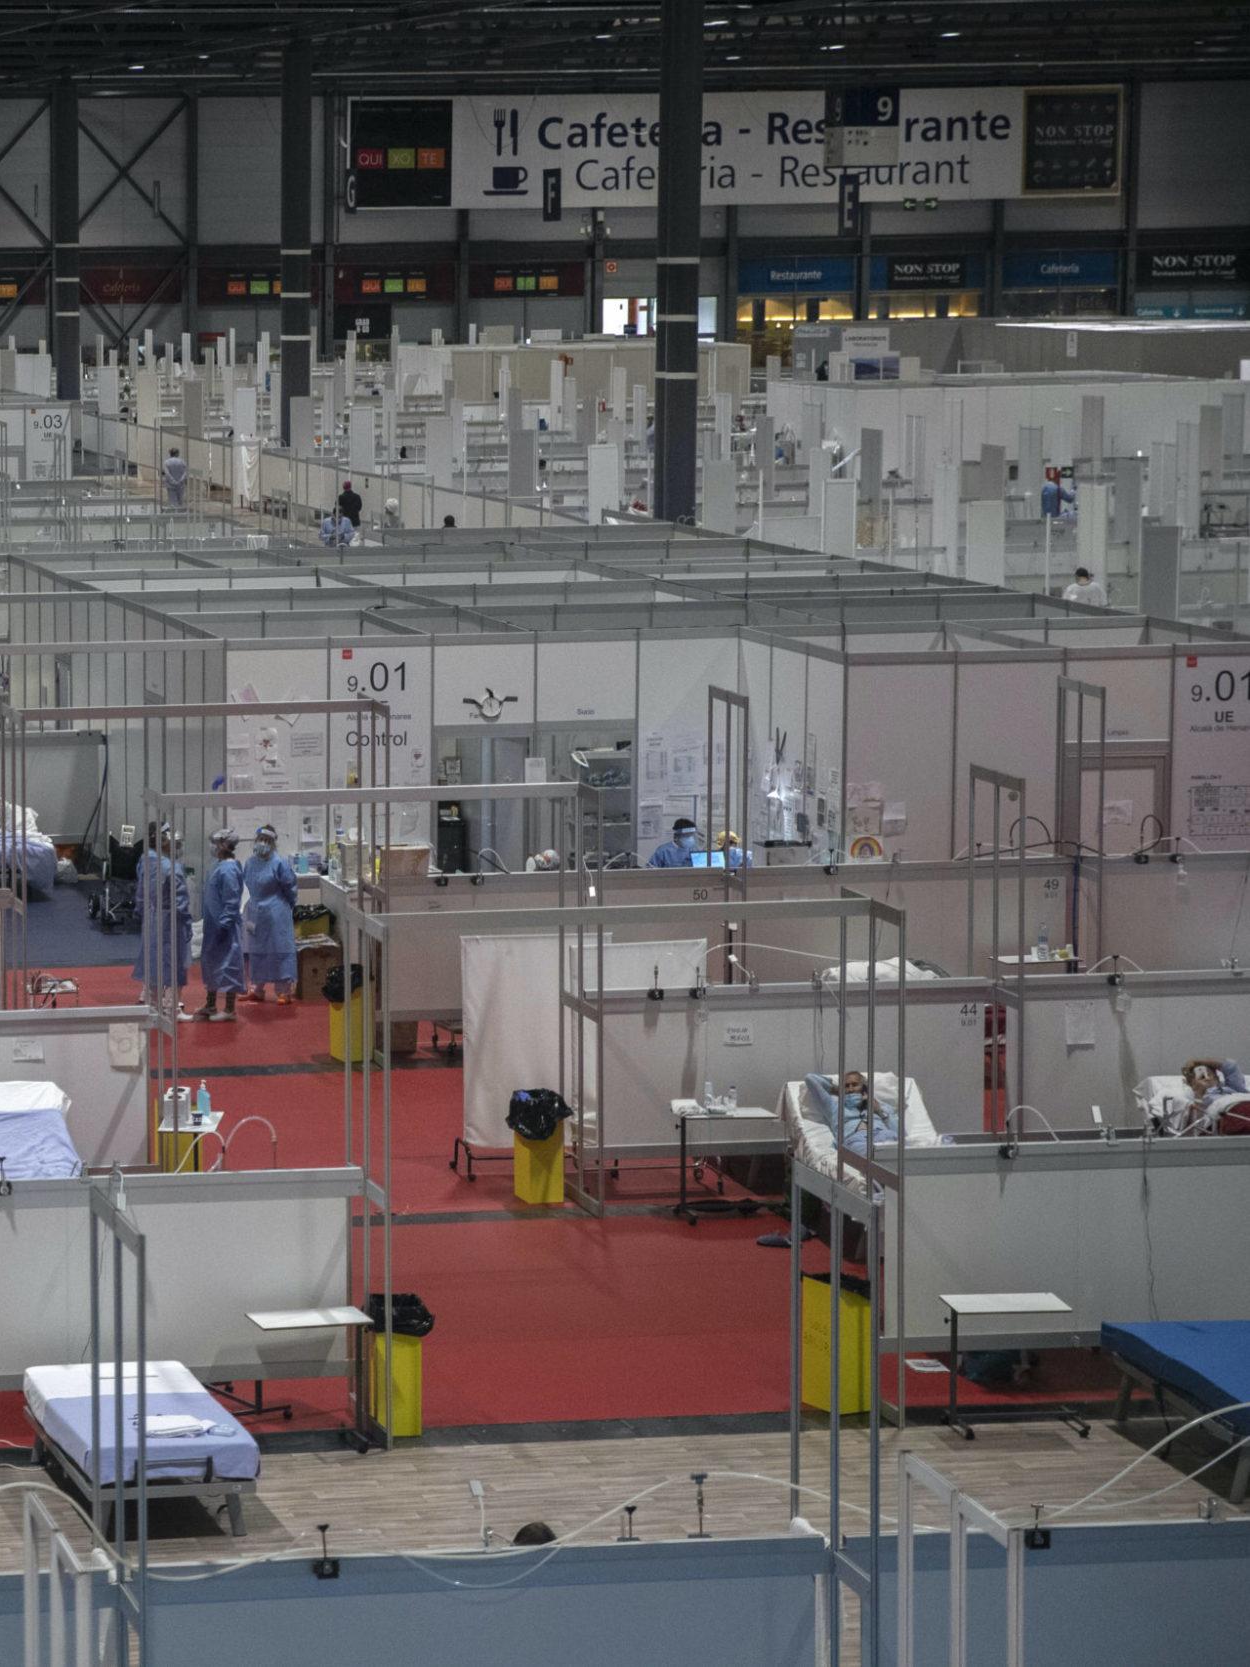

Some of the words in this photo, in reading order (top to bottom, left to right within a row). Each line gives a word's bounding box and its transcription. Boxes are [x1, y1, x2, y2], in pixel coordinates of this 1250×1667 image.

[876, 96, 893, 122] 9
[538, 112, 722, 150] Cafetea
[767, 110, 1012, 146] Resrante
[1035, 125, 1067, 138] NON
[1073, 123, 1114, 137] STOP
[358, 153, 383, 167] QUI
[421, 152, 437, 165] TE
[575, 155, 736, 191] Cafeia
[780, 154, 971, 188] Resaurant
[547, 176, 557, 214] F
[893, 263, 924, 275] NON
[926, 262, 961, 274] STOP
[1152, 255, 1189, 268] NON
[1192, 254, 1237, 268] STOP
[770, 269, 823, 281] Restaurante
[33, 414, 63, 429] 9.03
[347, 661, 406, 693] 9.01
[1190, 670, 1250, 702] 9.01
[1214, 711, 1234, 723] UE
[1043, 878, 1060, 890] 49
[693, 888, 708, 901] 50
[960, 1003, 978, 1017] 44
